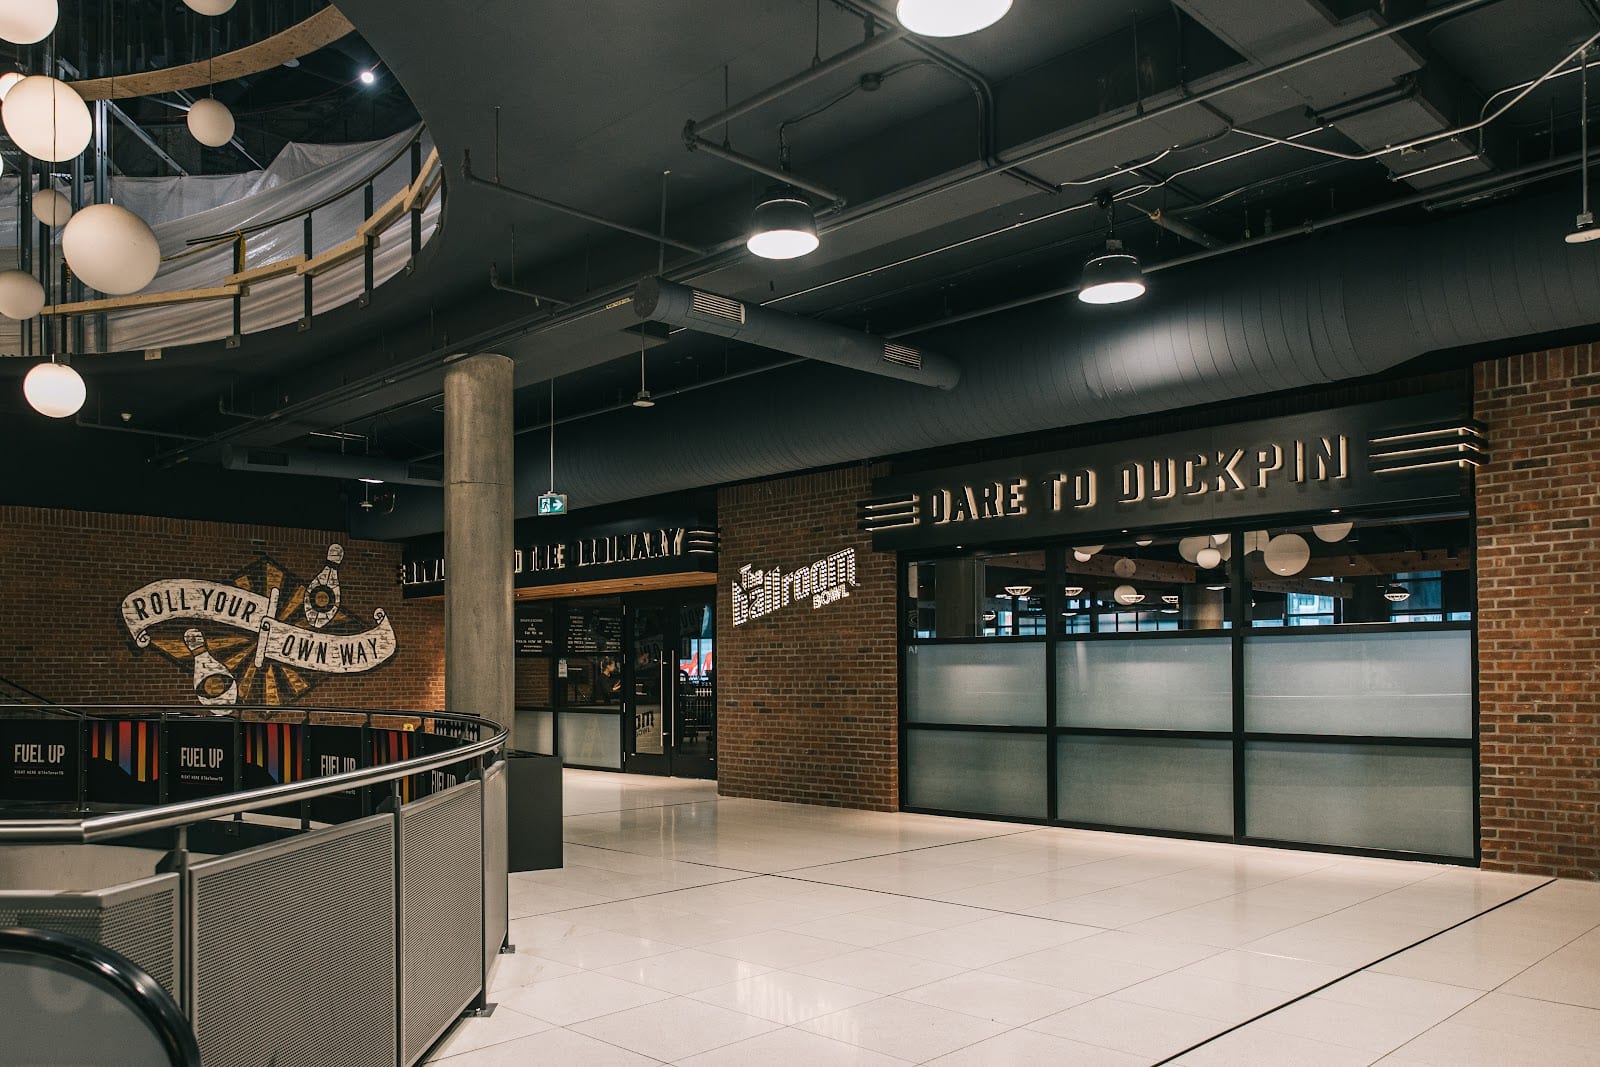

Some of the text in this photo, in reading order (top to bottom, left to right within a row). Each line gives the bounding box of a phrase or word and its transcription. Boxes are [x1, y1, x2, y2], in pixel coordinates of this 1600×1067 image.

[930, 433, 1349, 525] DARE TO DUCKPIN
[133, 588, 257, 623] ROLL YOUR
[813, 583, 850, 610] BOWL
[281, 634, 379, 666] OWN WAY
[14, 743, 65, 764] FUEL UP
[180, 747, 224, 769] FUEL UP
